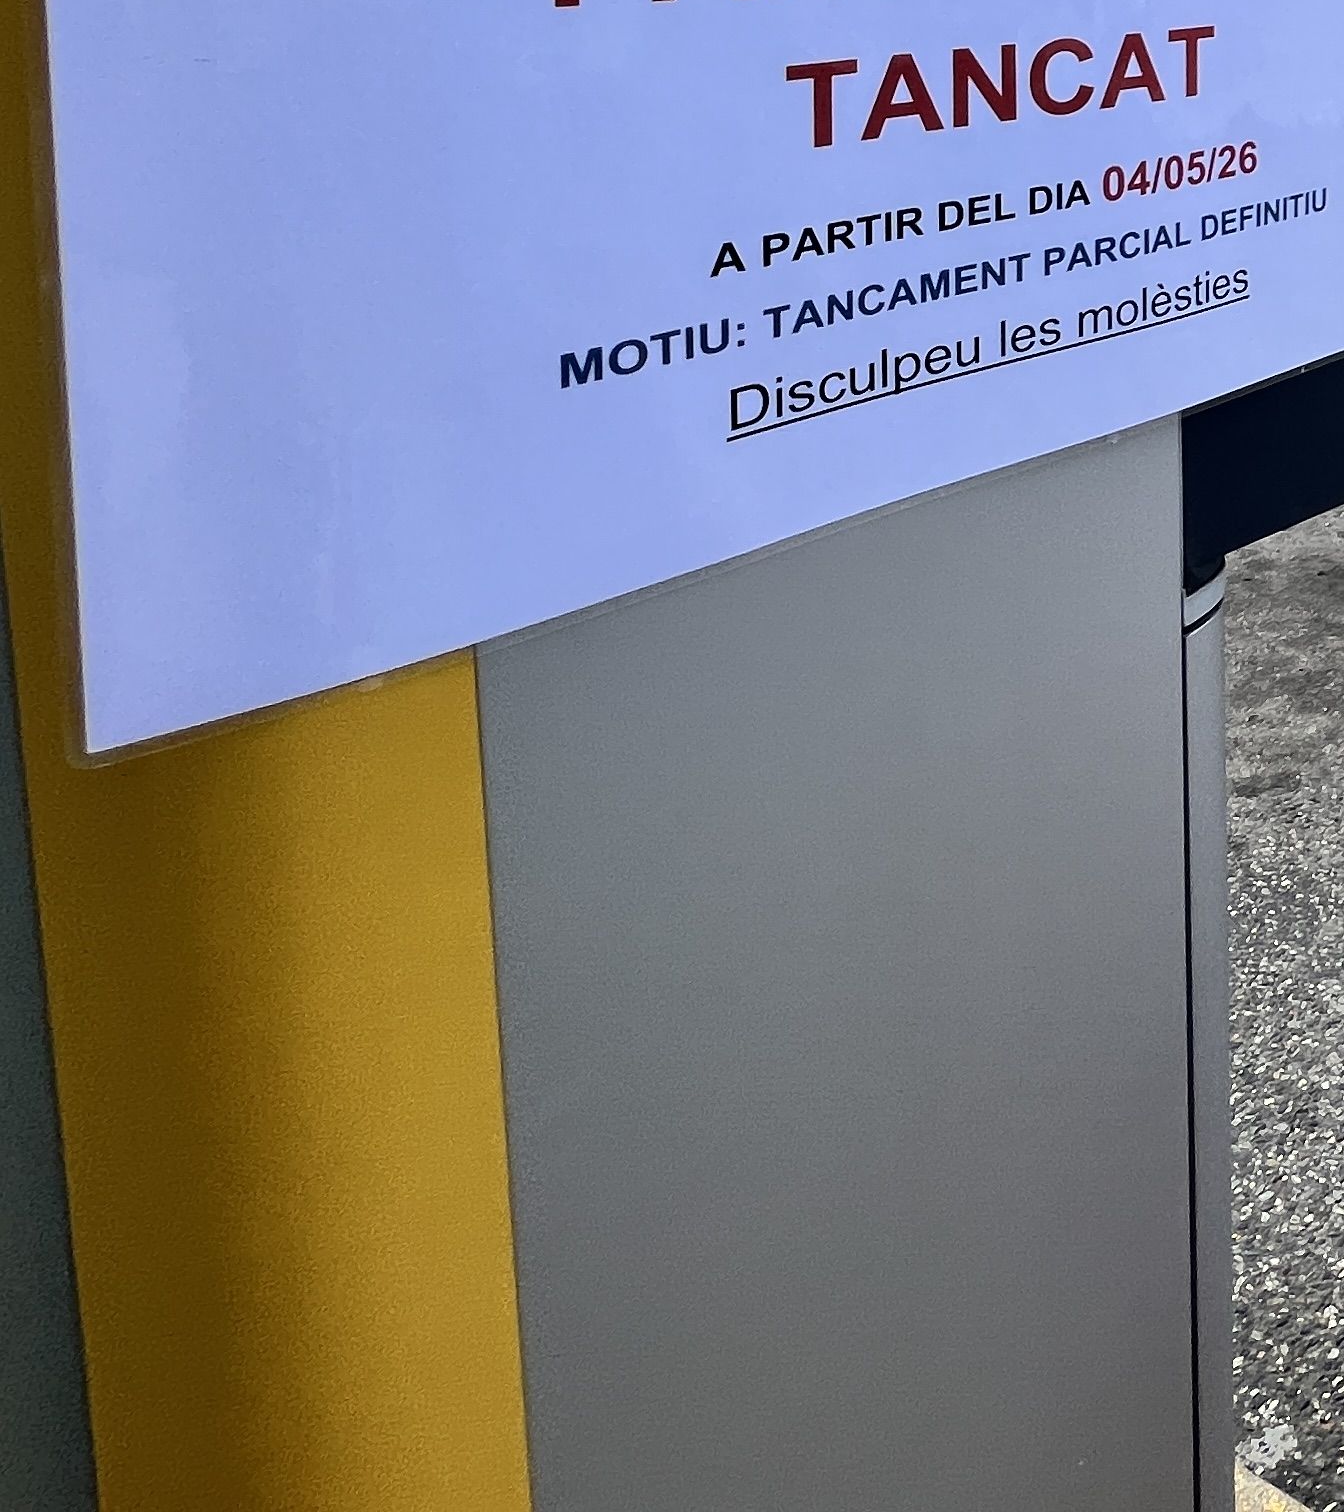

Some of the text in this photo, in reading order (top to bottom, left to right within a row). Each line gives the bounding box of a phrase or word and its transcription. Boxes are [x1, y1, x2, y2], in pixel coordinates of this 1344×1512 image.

[786, 26, 1214, 147] TANCAT
[710, 142, 1257, 278] A PARTIR DEL DIA 04/05/26
[560, 188, 1326, 389] MOTIU: TANCAMENT PARCIAL DEFINITIU
[730, 270, 1248, 431] Disculpeu les molèsties
